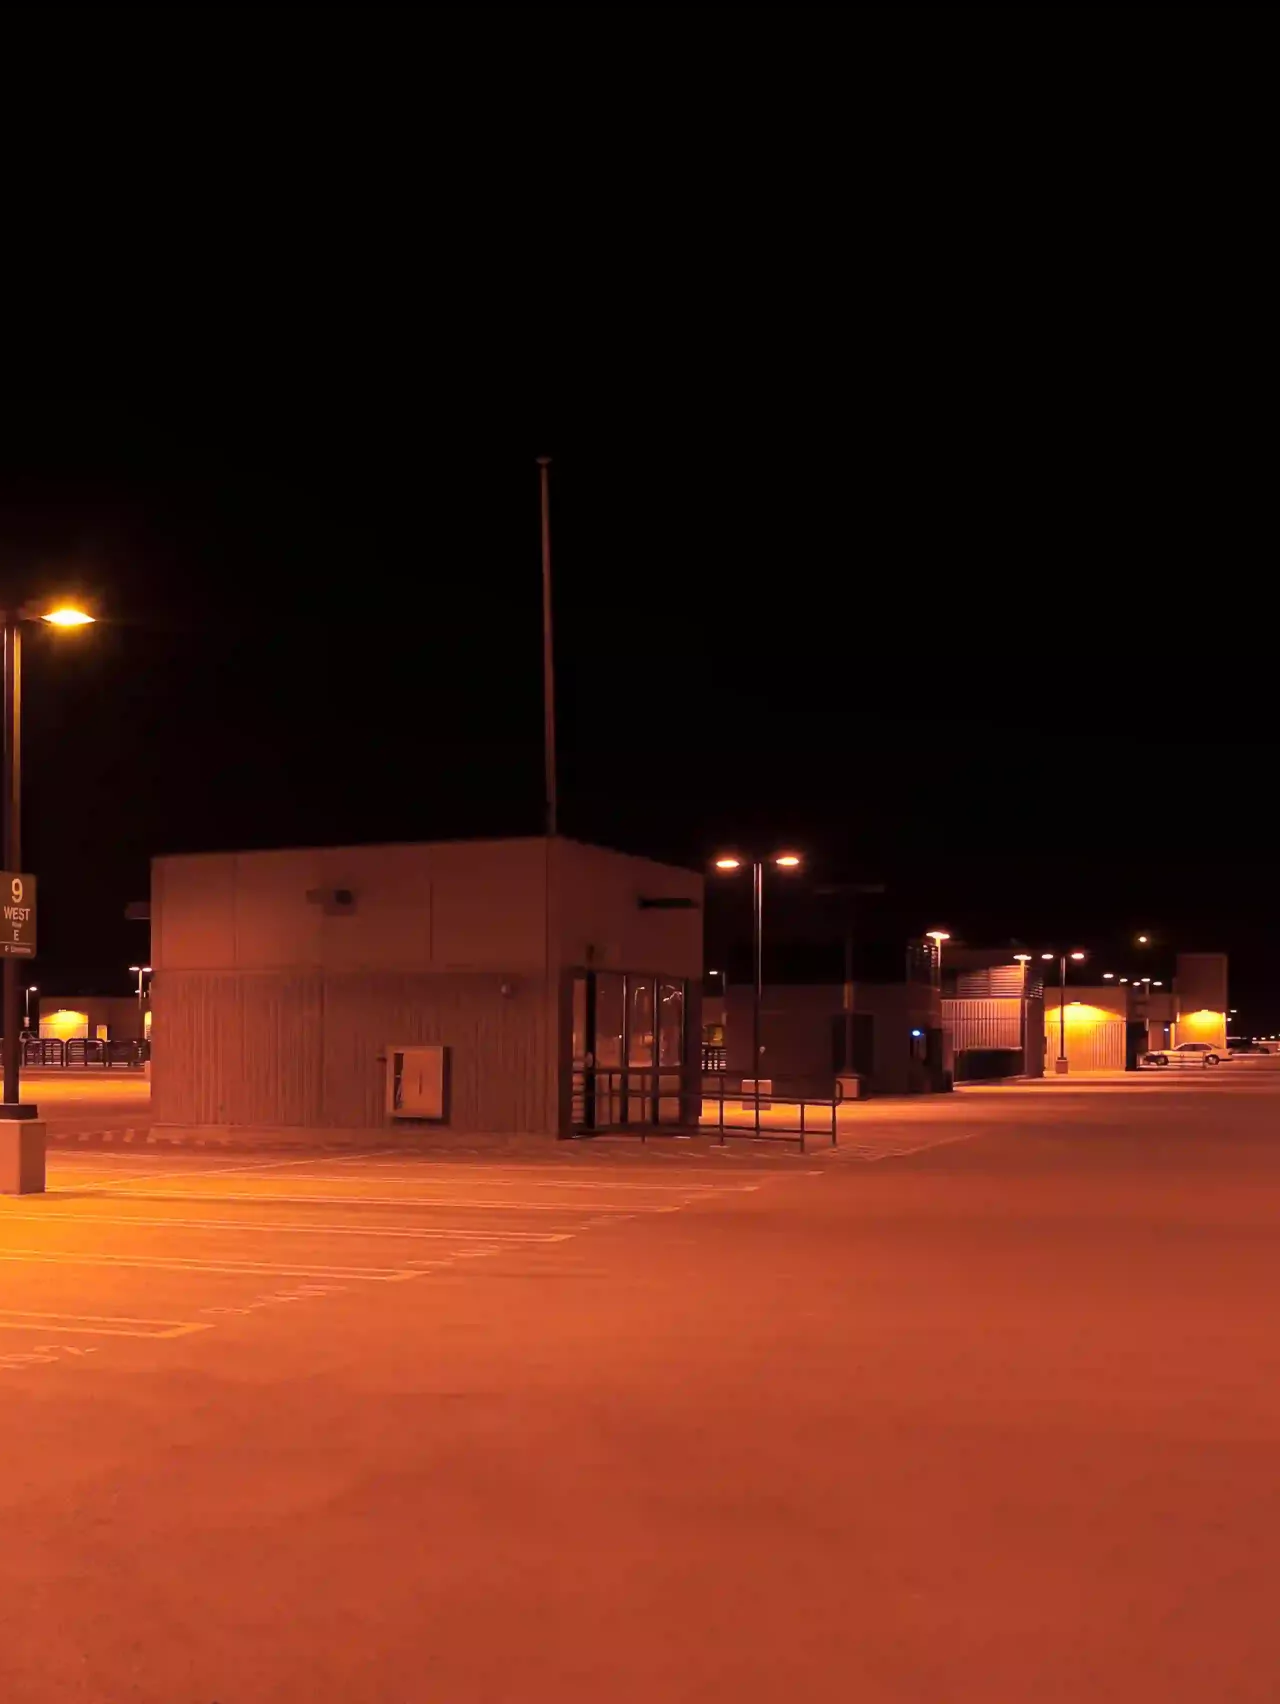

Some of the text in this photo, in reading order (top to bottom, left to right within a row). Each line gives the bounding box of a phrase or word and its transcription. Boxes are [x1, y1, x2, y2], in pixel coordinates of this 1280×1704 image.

[11, 878, 23, 903] 9
[3, 905, 31, 921] WEST
[13, 929, 20, 941] E
